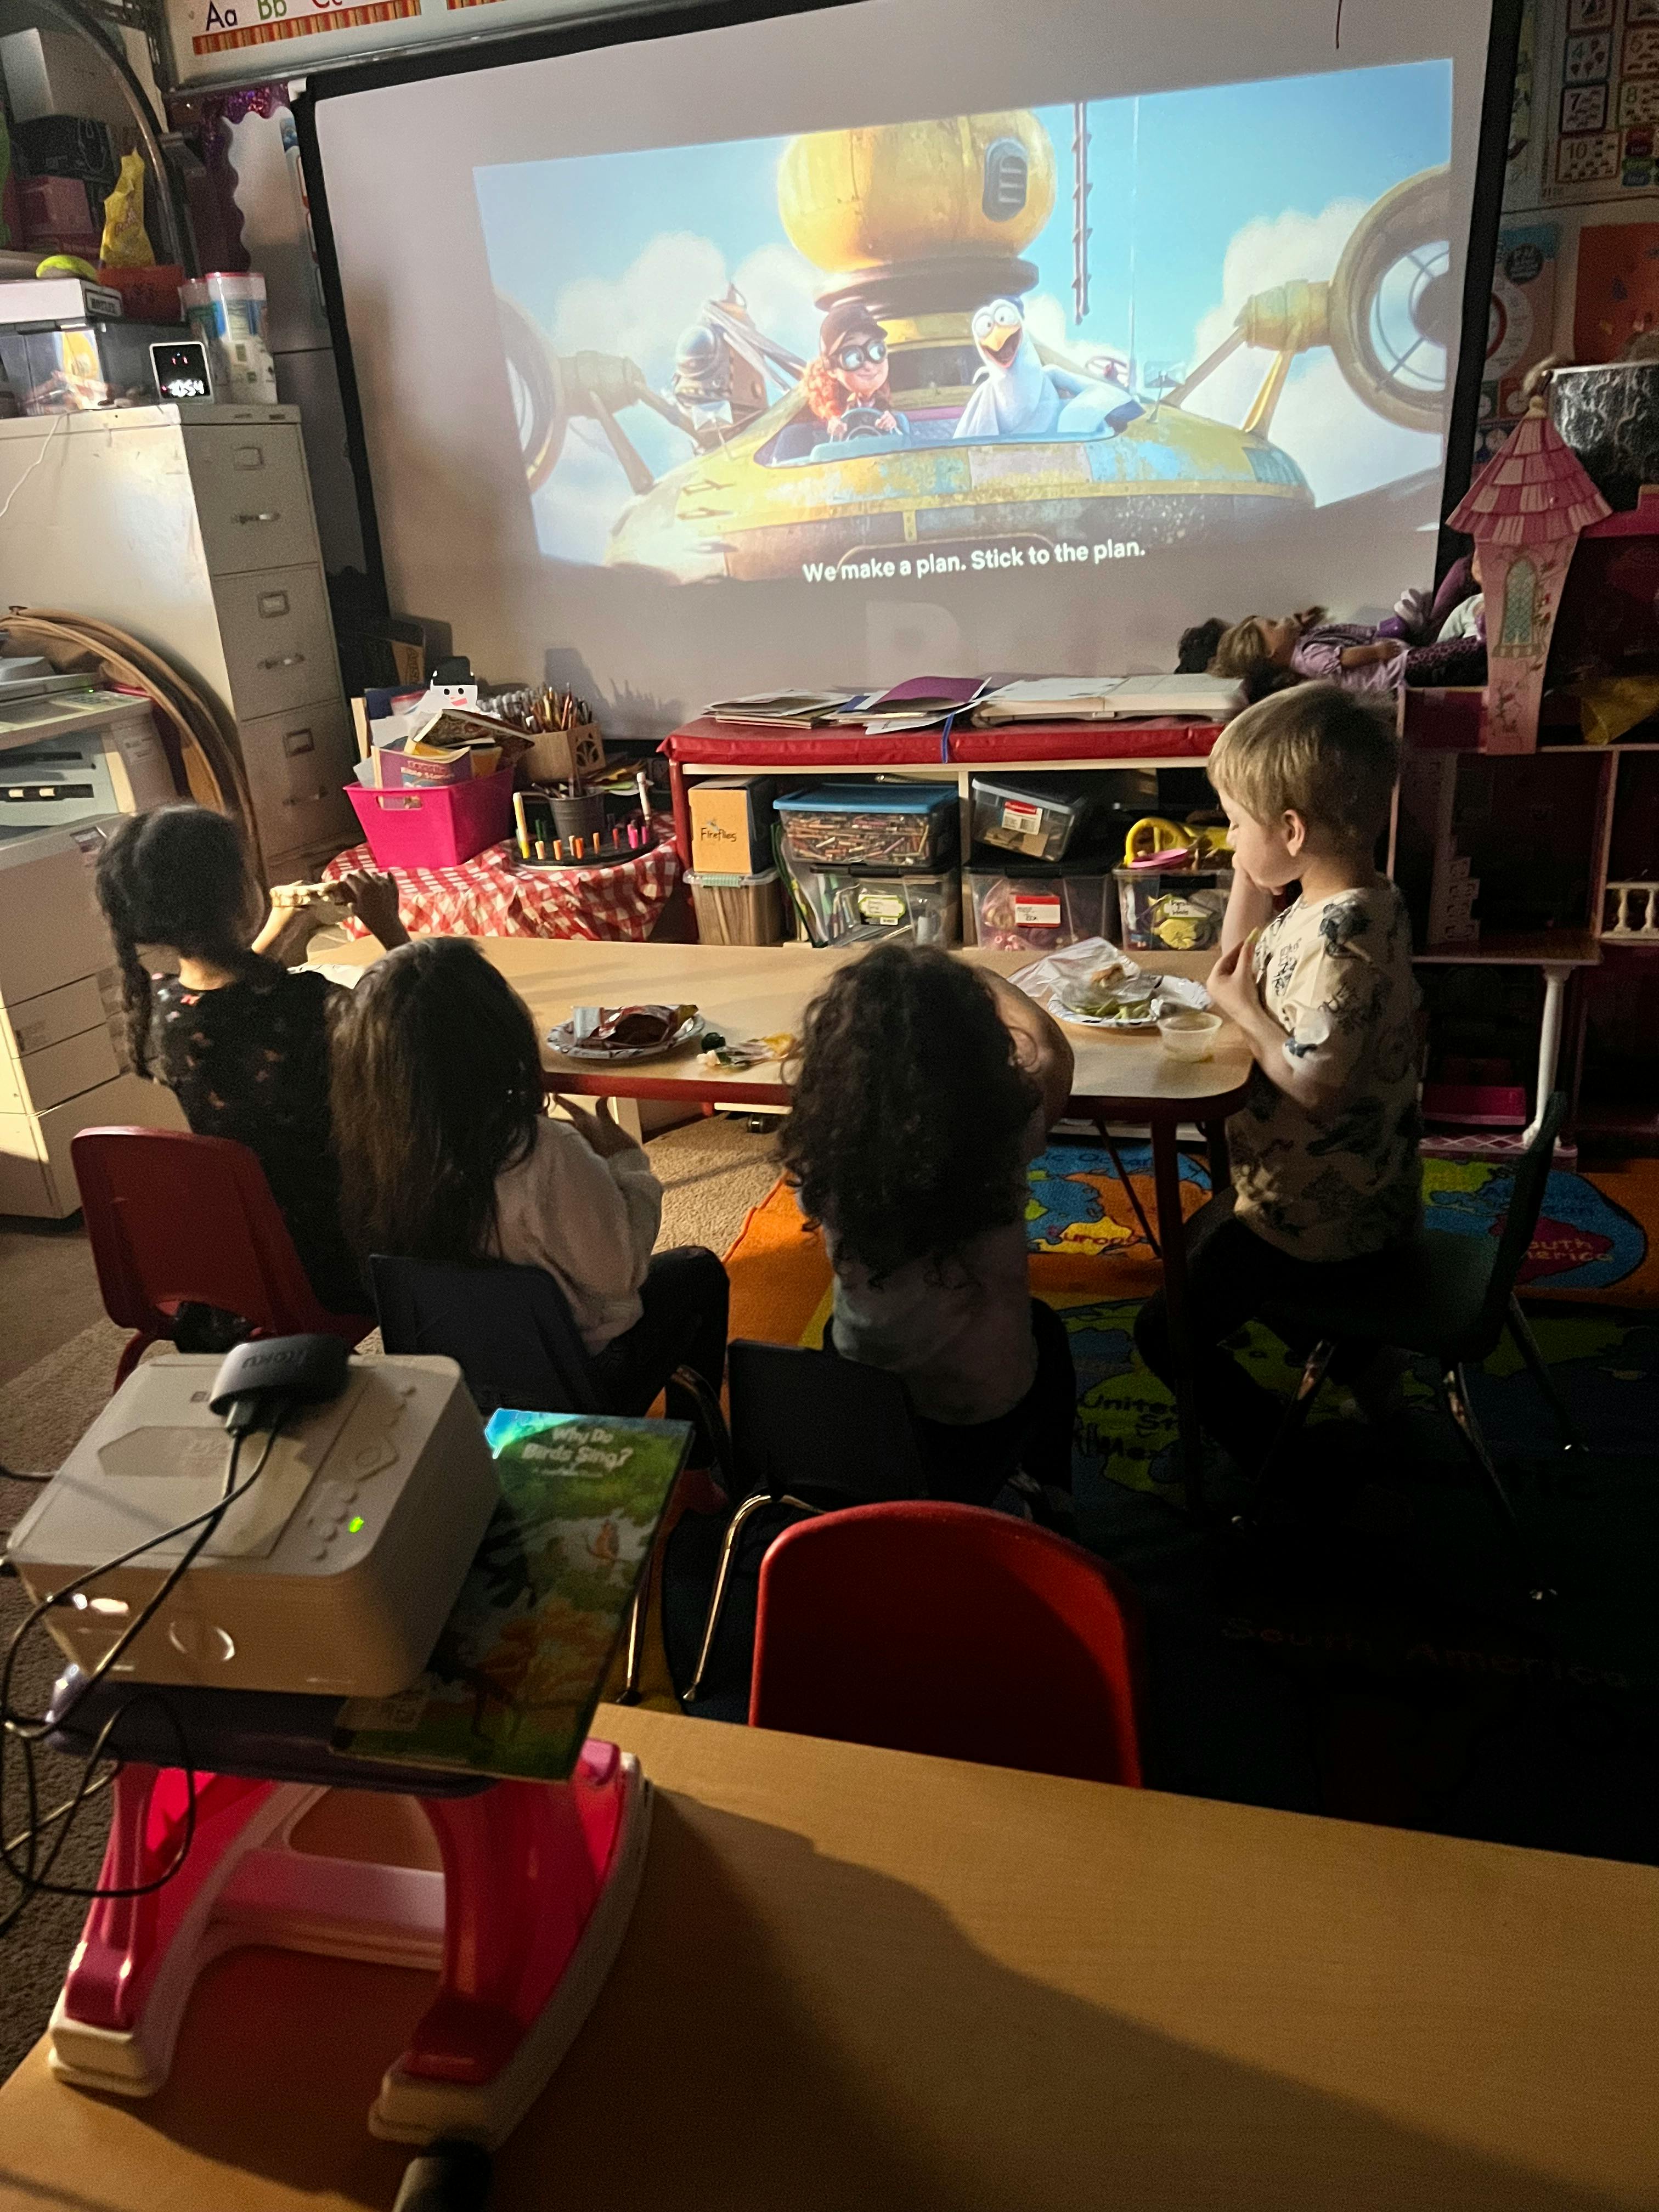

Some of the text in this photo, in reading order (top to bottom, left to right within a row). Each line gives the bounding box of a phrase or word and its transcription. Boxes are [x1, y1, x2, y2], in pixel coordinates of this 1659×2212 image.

[206, 1, 238, 31] Aa
[1571, 93, 1581, 110] 7
[1566, 142, 1587, 159] 10
[802, 539, 1146, 582] We make a plan. Stick to the plan.
[552, 1427, 614, 1446] Why Do
[522, 1443, 633, 1472] Birds Sing?
